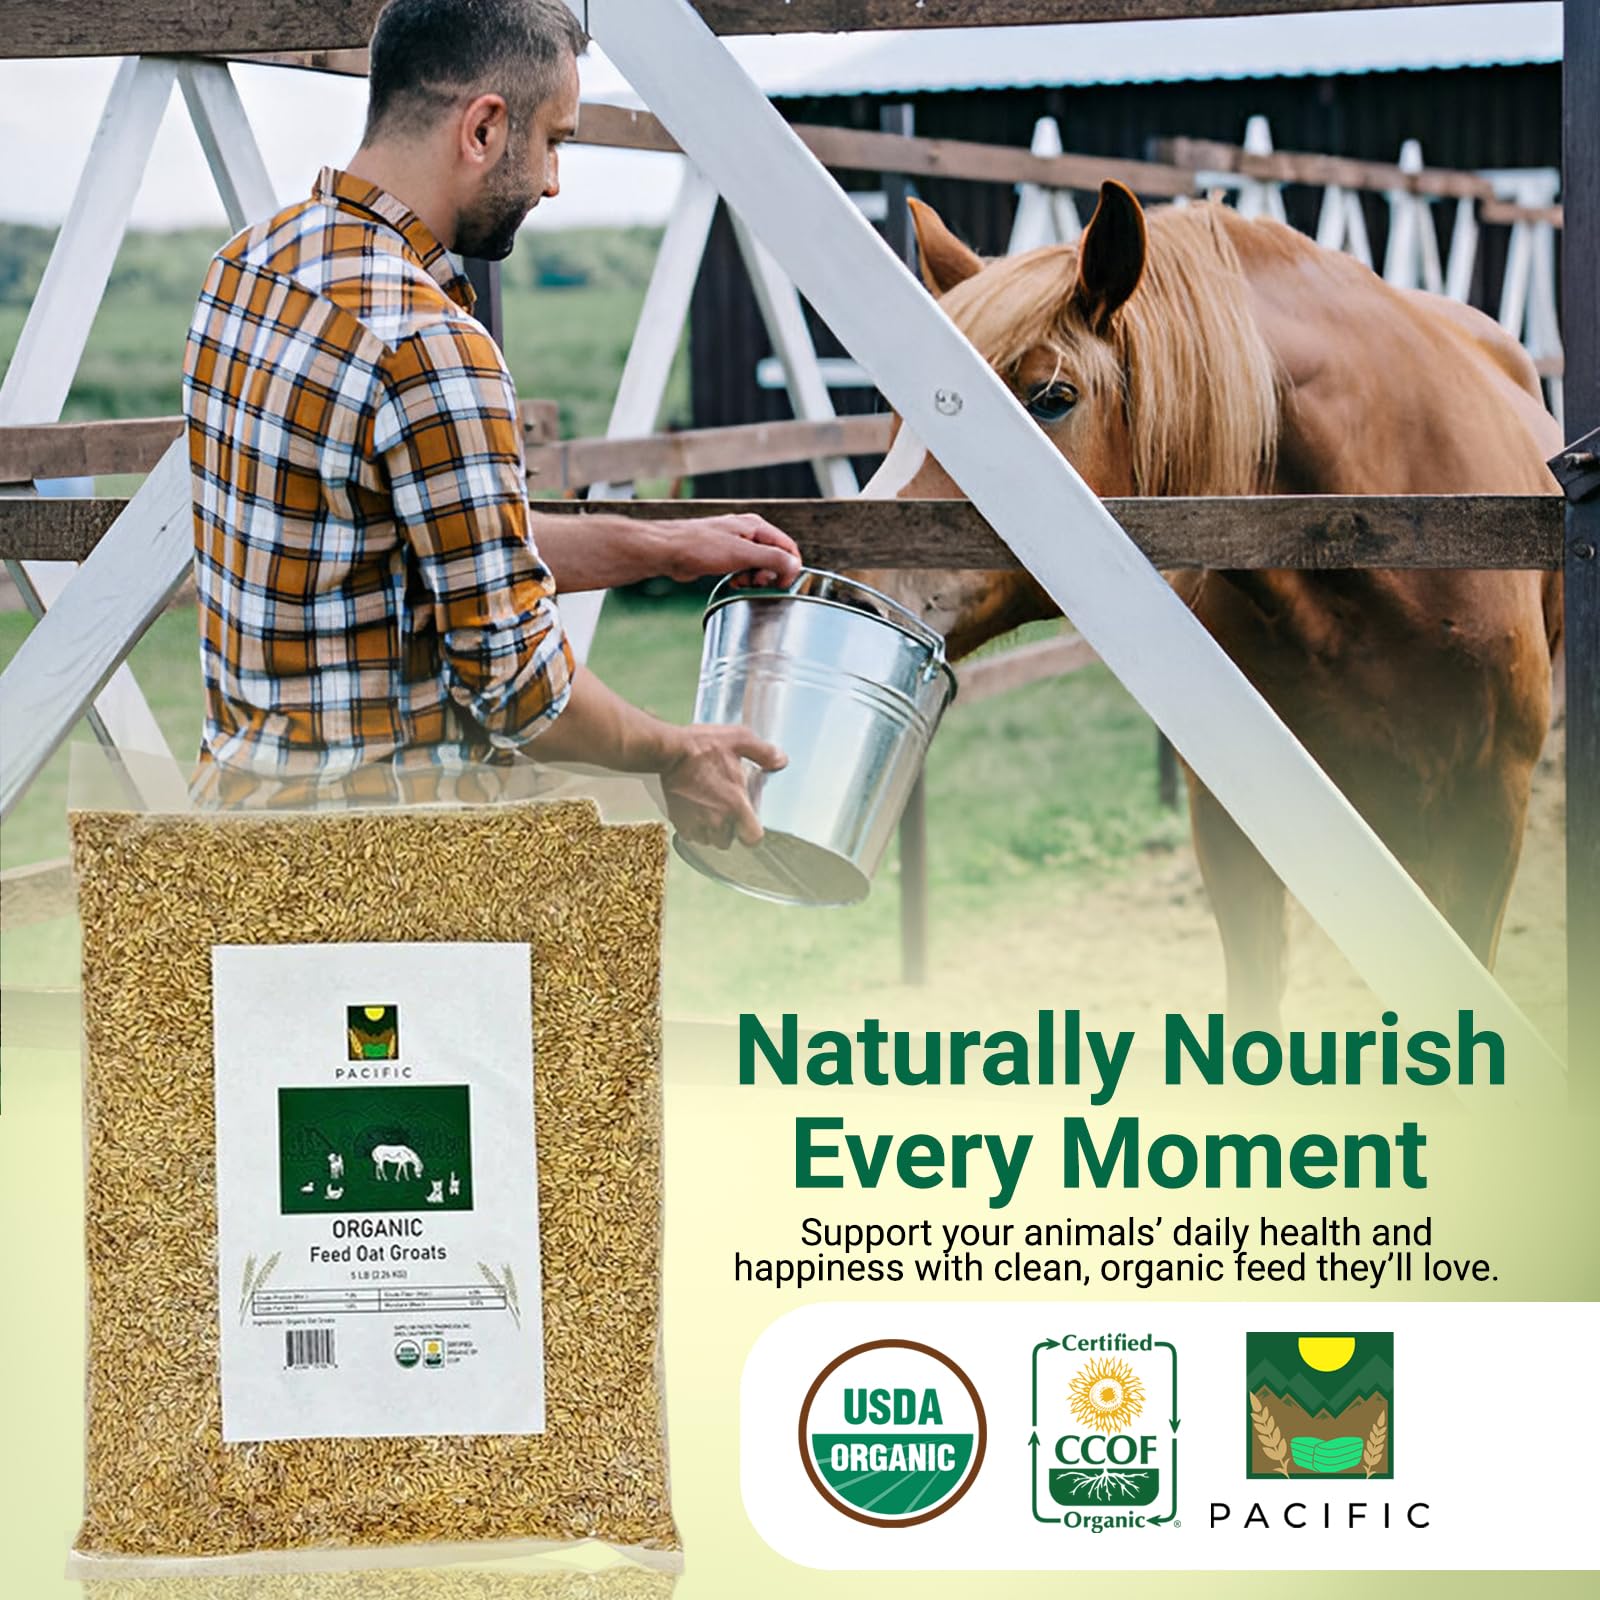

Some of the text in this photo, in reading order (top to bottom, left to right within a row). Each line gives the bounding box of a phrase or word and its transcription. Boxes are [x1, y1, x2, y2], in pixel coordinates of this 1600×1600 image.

[335, 1066, 413, 1079] PACIFIC
[332, 1218, 424, 1239] ORGANIC
[310, 1243, 447, 1263] Feed Oat Groats
[358, 1271, 370, 1280] LB
